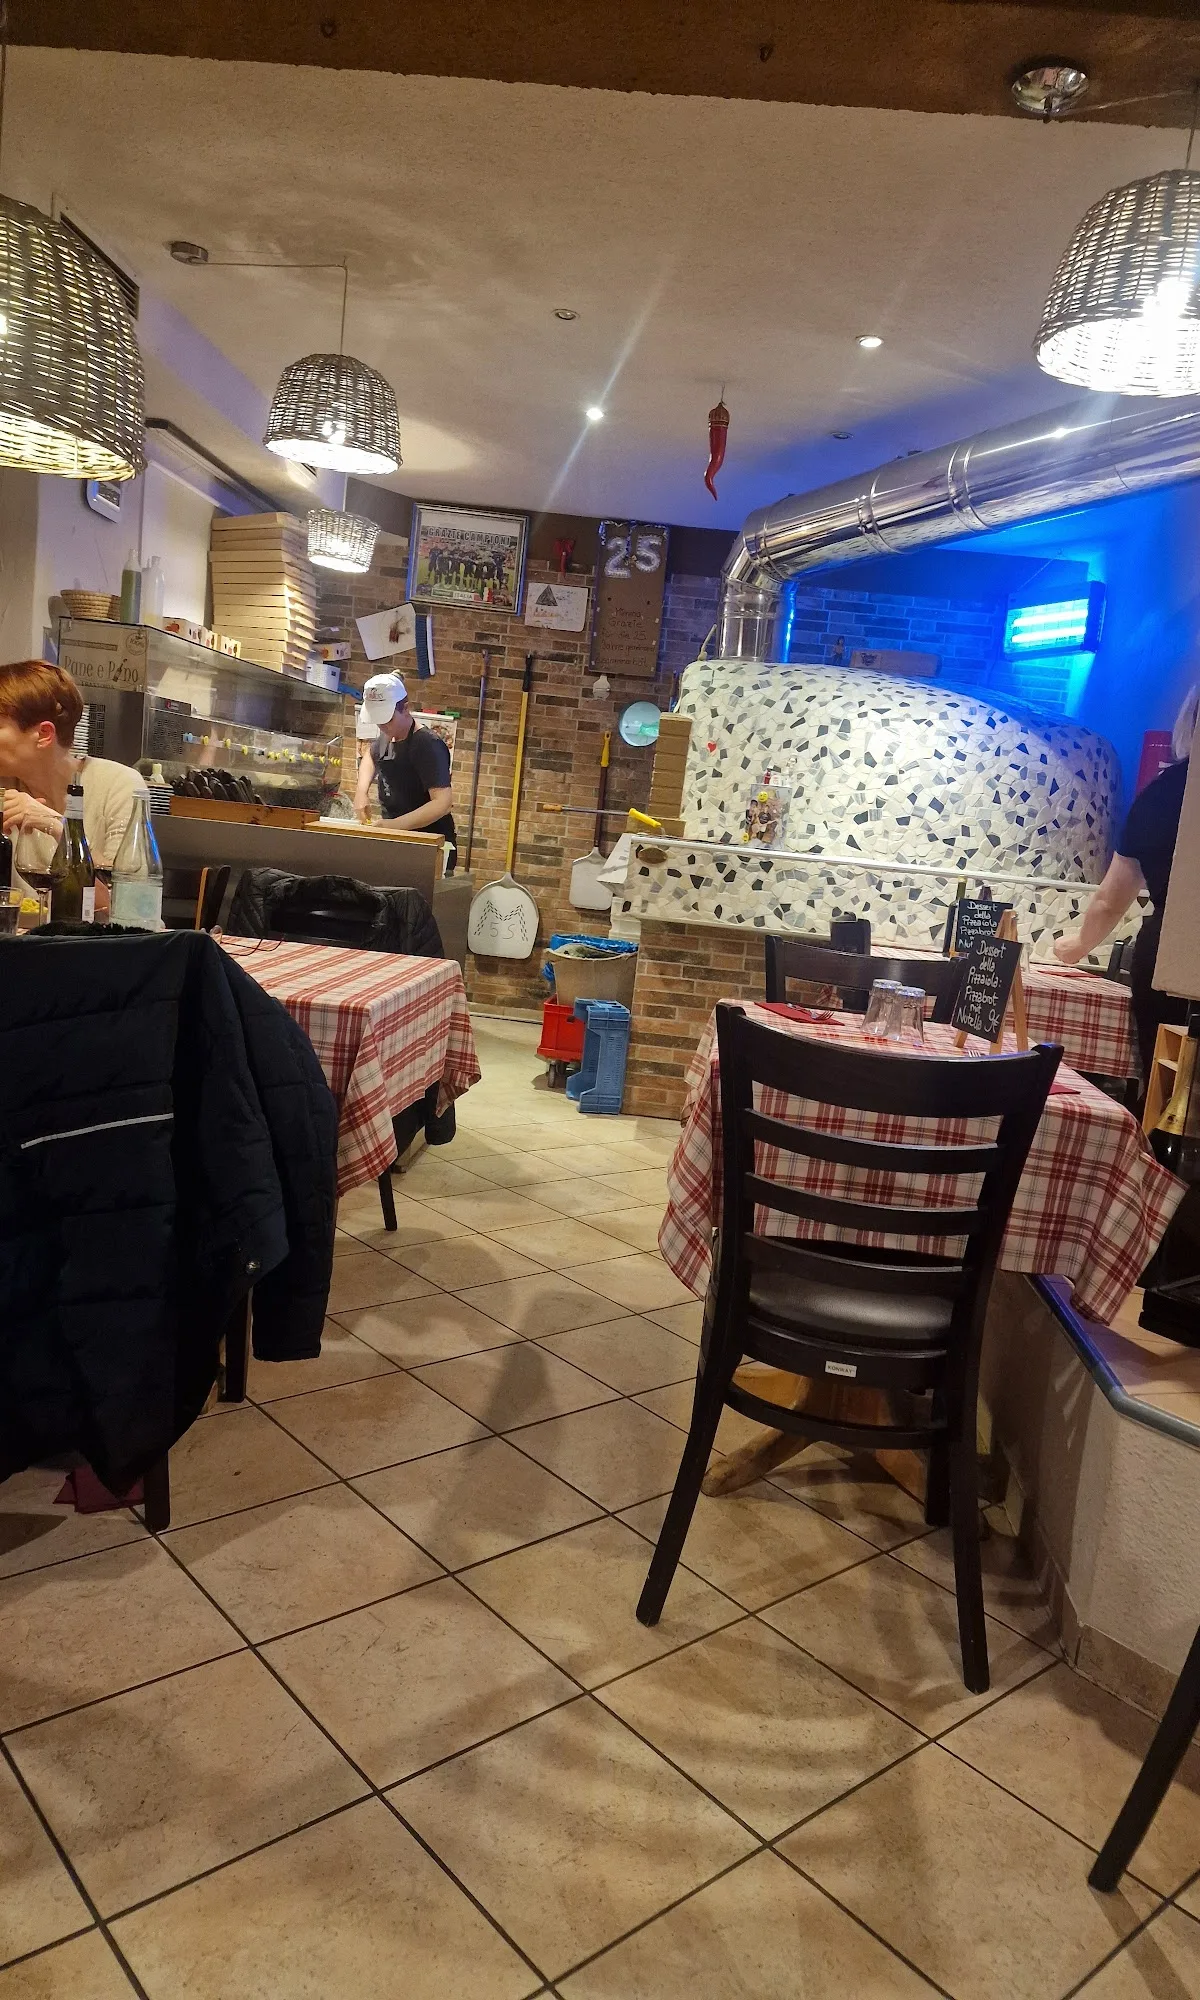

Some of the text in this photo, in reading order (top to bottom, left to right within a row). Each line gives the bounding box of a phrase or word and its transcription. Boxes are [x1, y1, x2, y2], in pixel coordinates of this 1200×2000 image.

[428, 526, 513, 546] GRAZIE CAMPIONI
[604, 534, 662, 578] 25
[633, 630, 647, 640] 25
[64, 655, 93, 677] Pane
[97, 664, 104, 679] e
[976, 940, 1007, 959] Dessert
[979, 956, 996, 972] della
[968, 966, 1002, 988] Pizzaiola:
[964, 985, 999, 1006] Pizzabrot
[970, 1003, 982, 1015] mit
